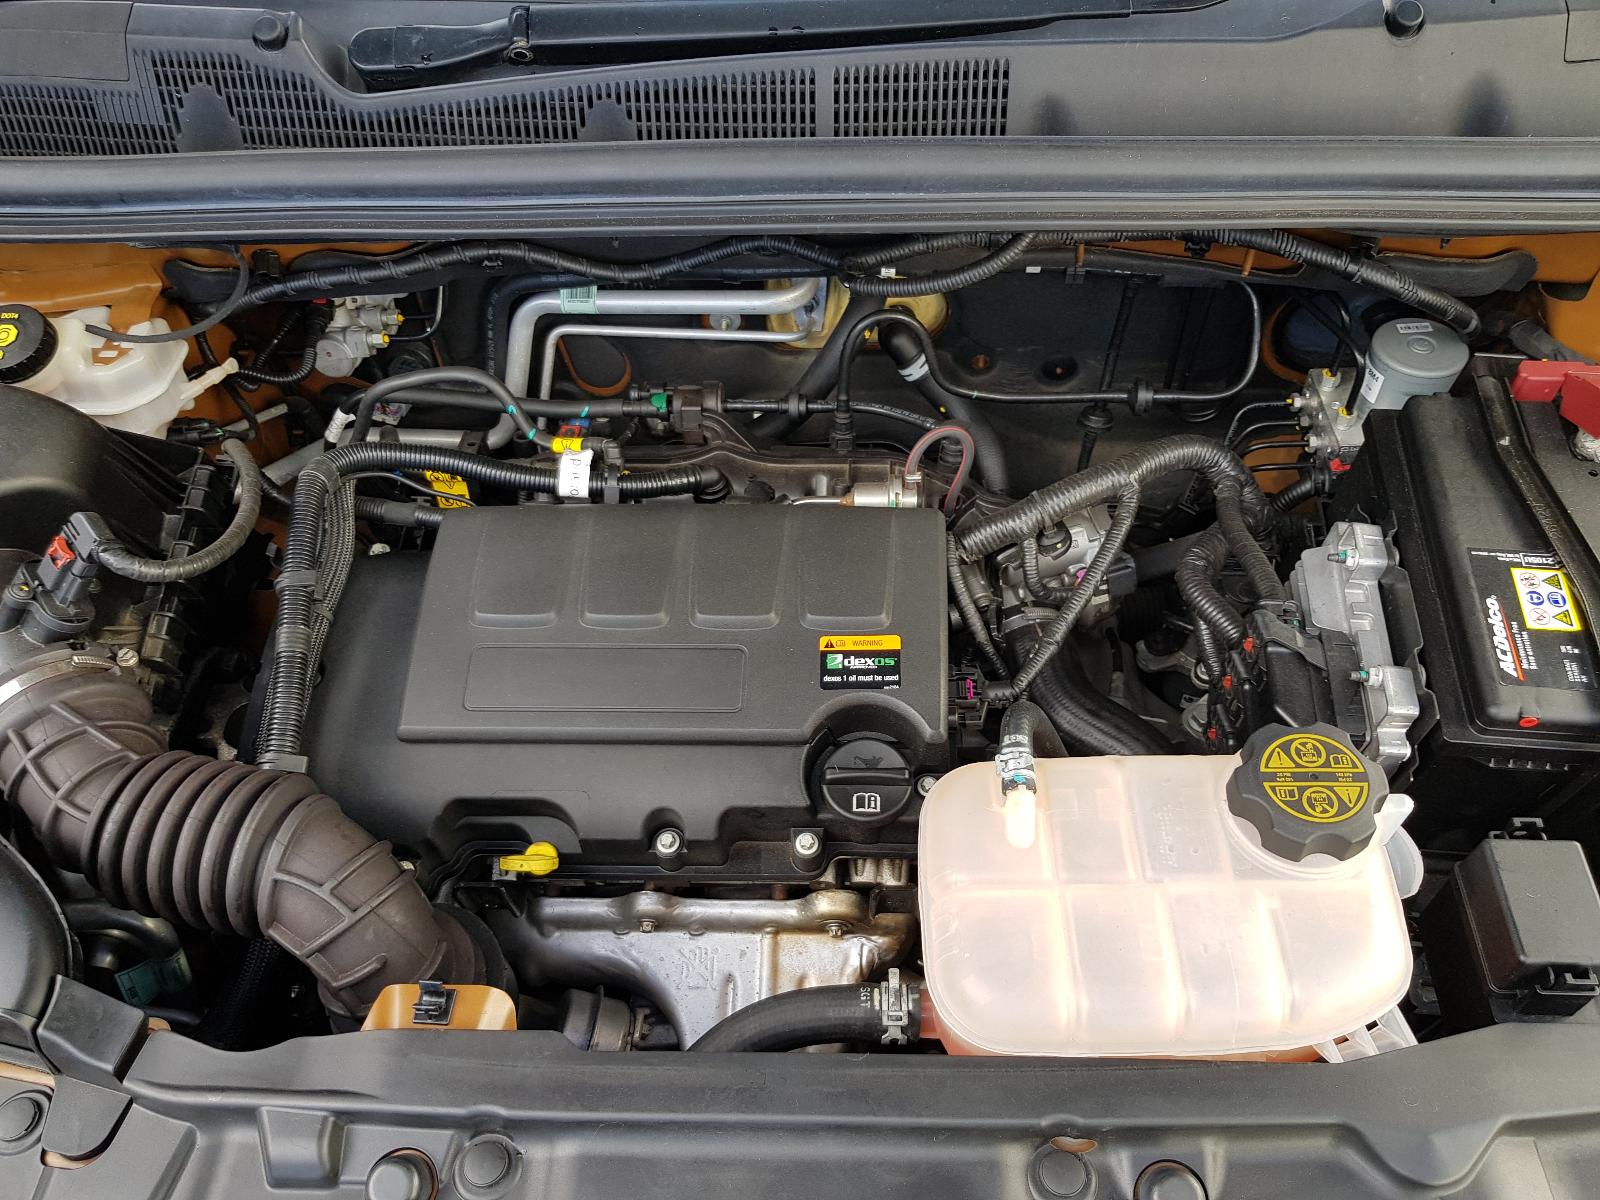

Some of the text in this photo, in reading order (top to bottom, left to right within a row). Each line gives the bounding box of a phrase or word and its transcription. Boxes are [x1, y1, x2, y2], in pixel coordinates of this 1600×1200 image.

[1486, 597, 1518, 677] ACDelco
[851, 639, 883, 647] WARNING
[843, 655, 896, 666] dexos
[823, 674, 842, 682] dexos
[848, 674, 857, 682] oil
[857, 674, 874, 682] must
[874, 674, 883, 682] be
[883, 674, 899, 682] used
